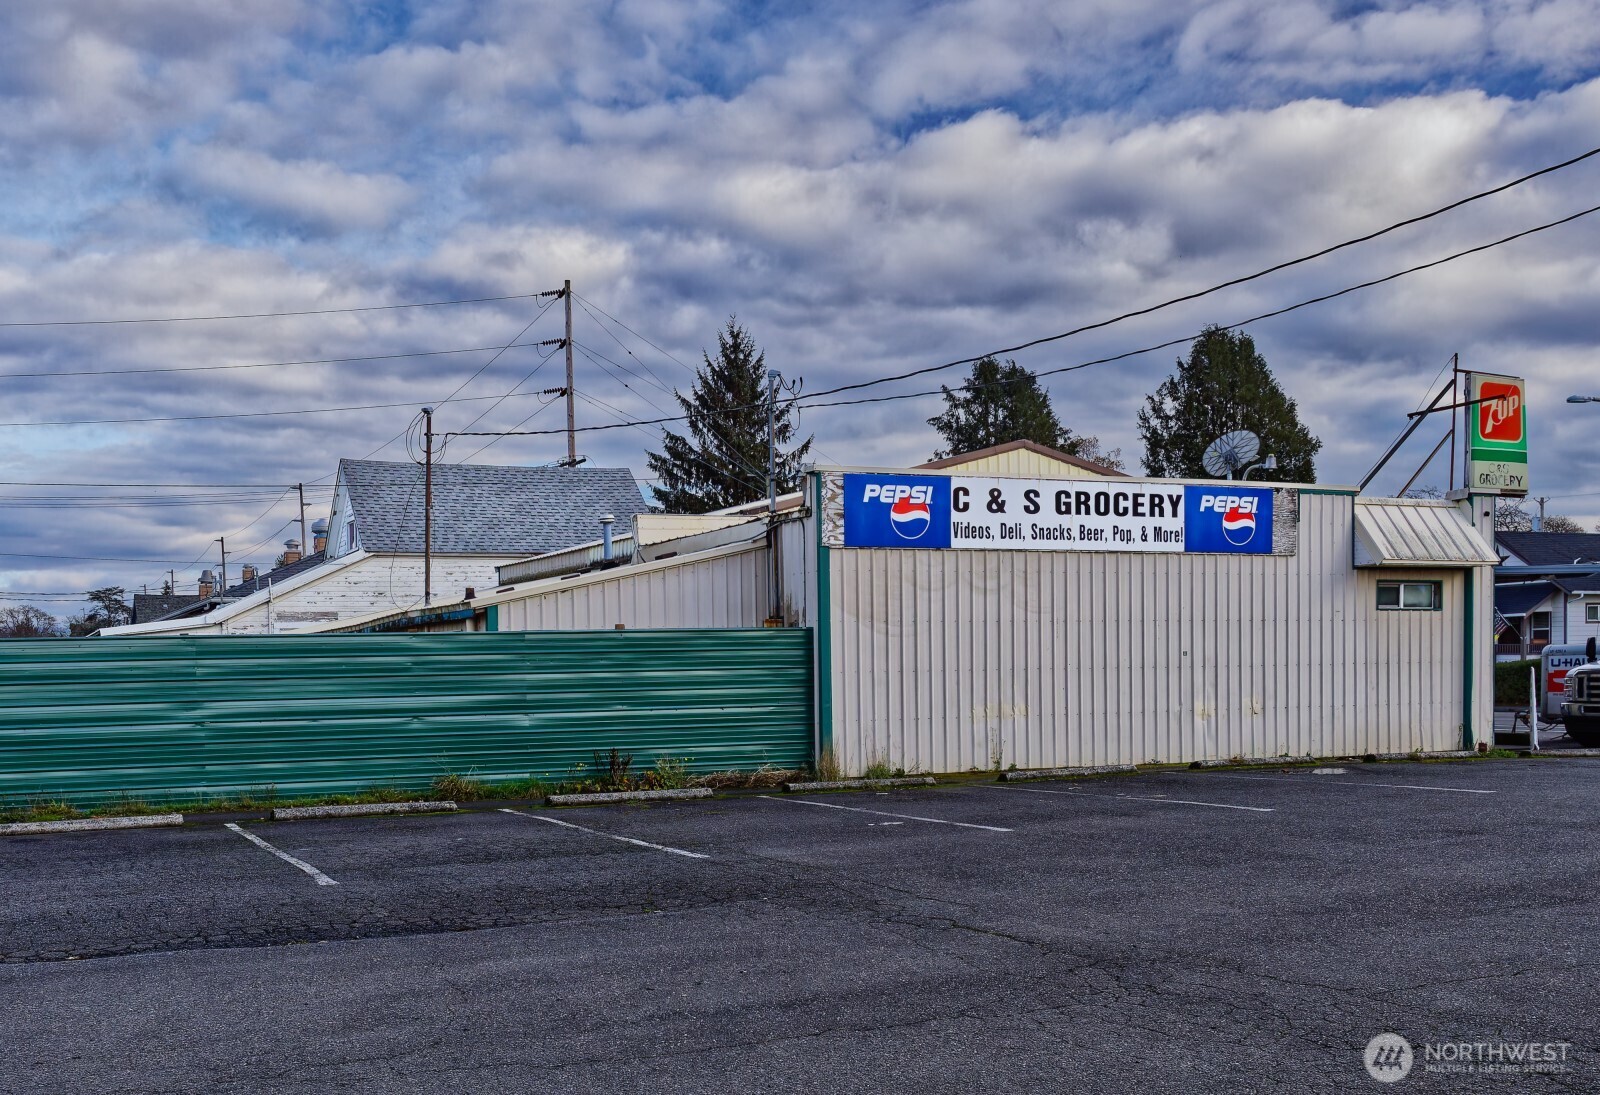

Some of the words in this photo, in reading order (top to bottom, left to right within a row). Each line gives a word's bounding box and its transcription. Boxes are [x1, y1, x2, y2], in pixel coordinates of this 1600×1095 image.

[863, 483, 933, 504] PEPSI
[953, 487, 970, 513] C
[986, 488, 1006, 514] &
[1023, 489, 1041, 515] S
[1055, 490, 1183, 518] GROCERY
[1200, 495, 1258, 514] PEPSI
[953, 522, 995, 541] Videos,
[1000, 523, 1026, 542] Deli,
[1031, 524, 1076, 543] Snacks,
[1079, 525, 1108, 542] Beer,
[1112, 526, 1136, 544] Pop,
[1140, 528, 1148, 543] &
[1154, 527, 1184, 543] More!
